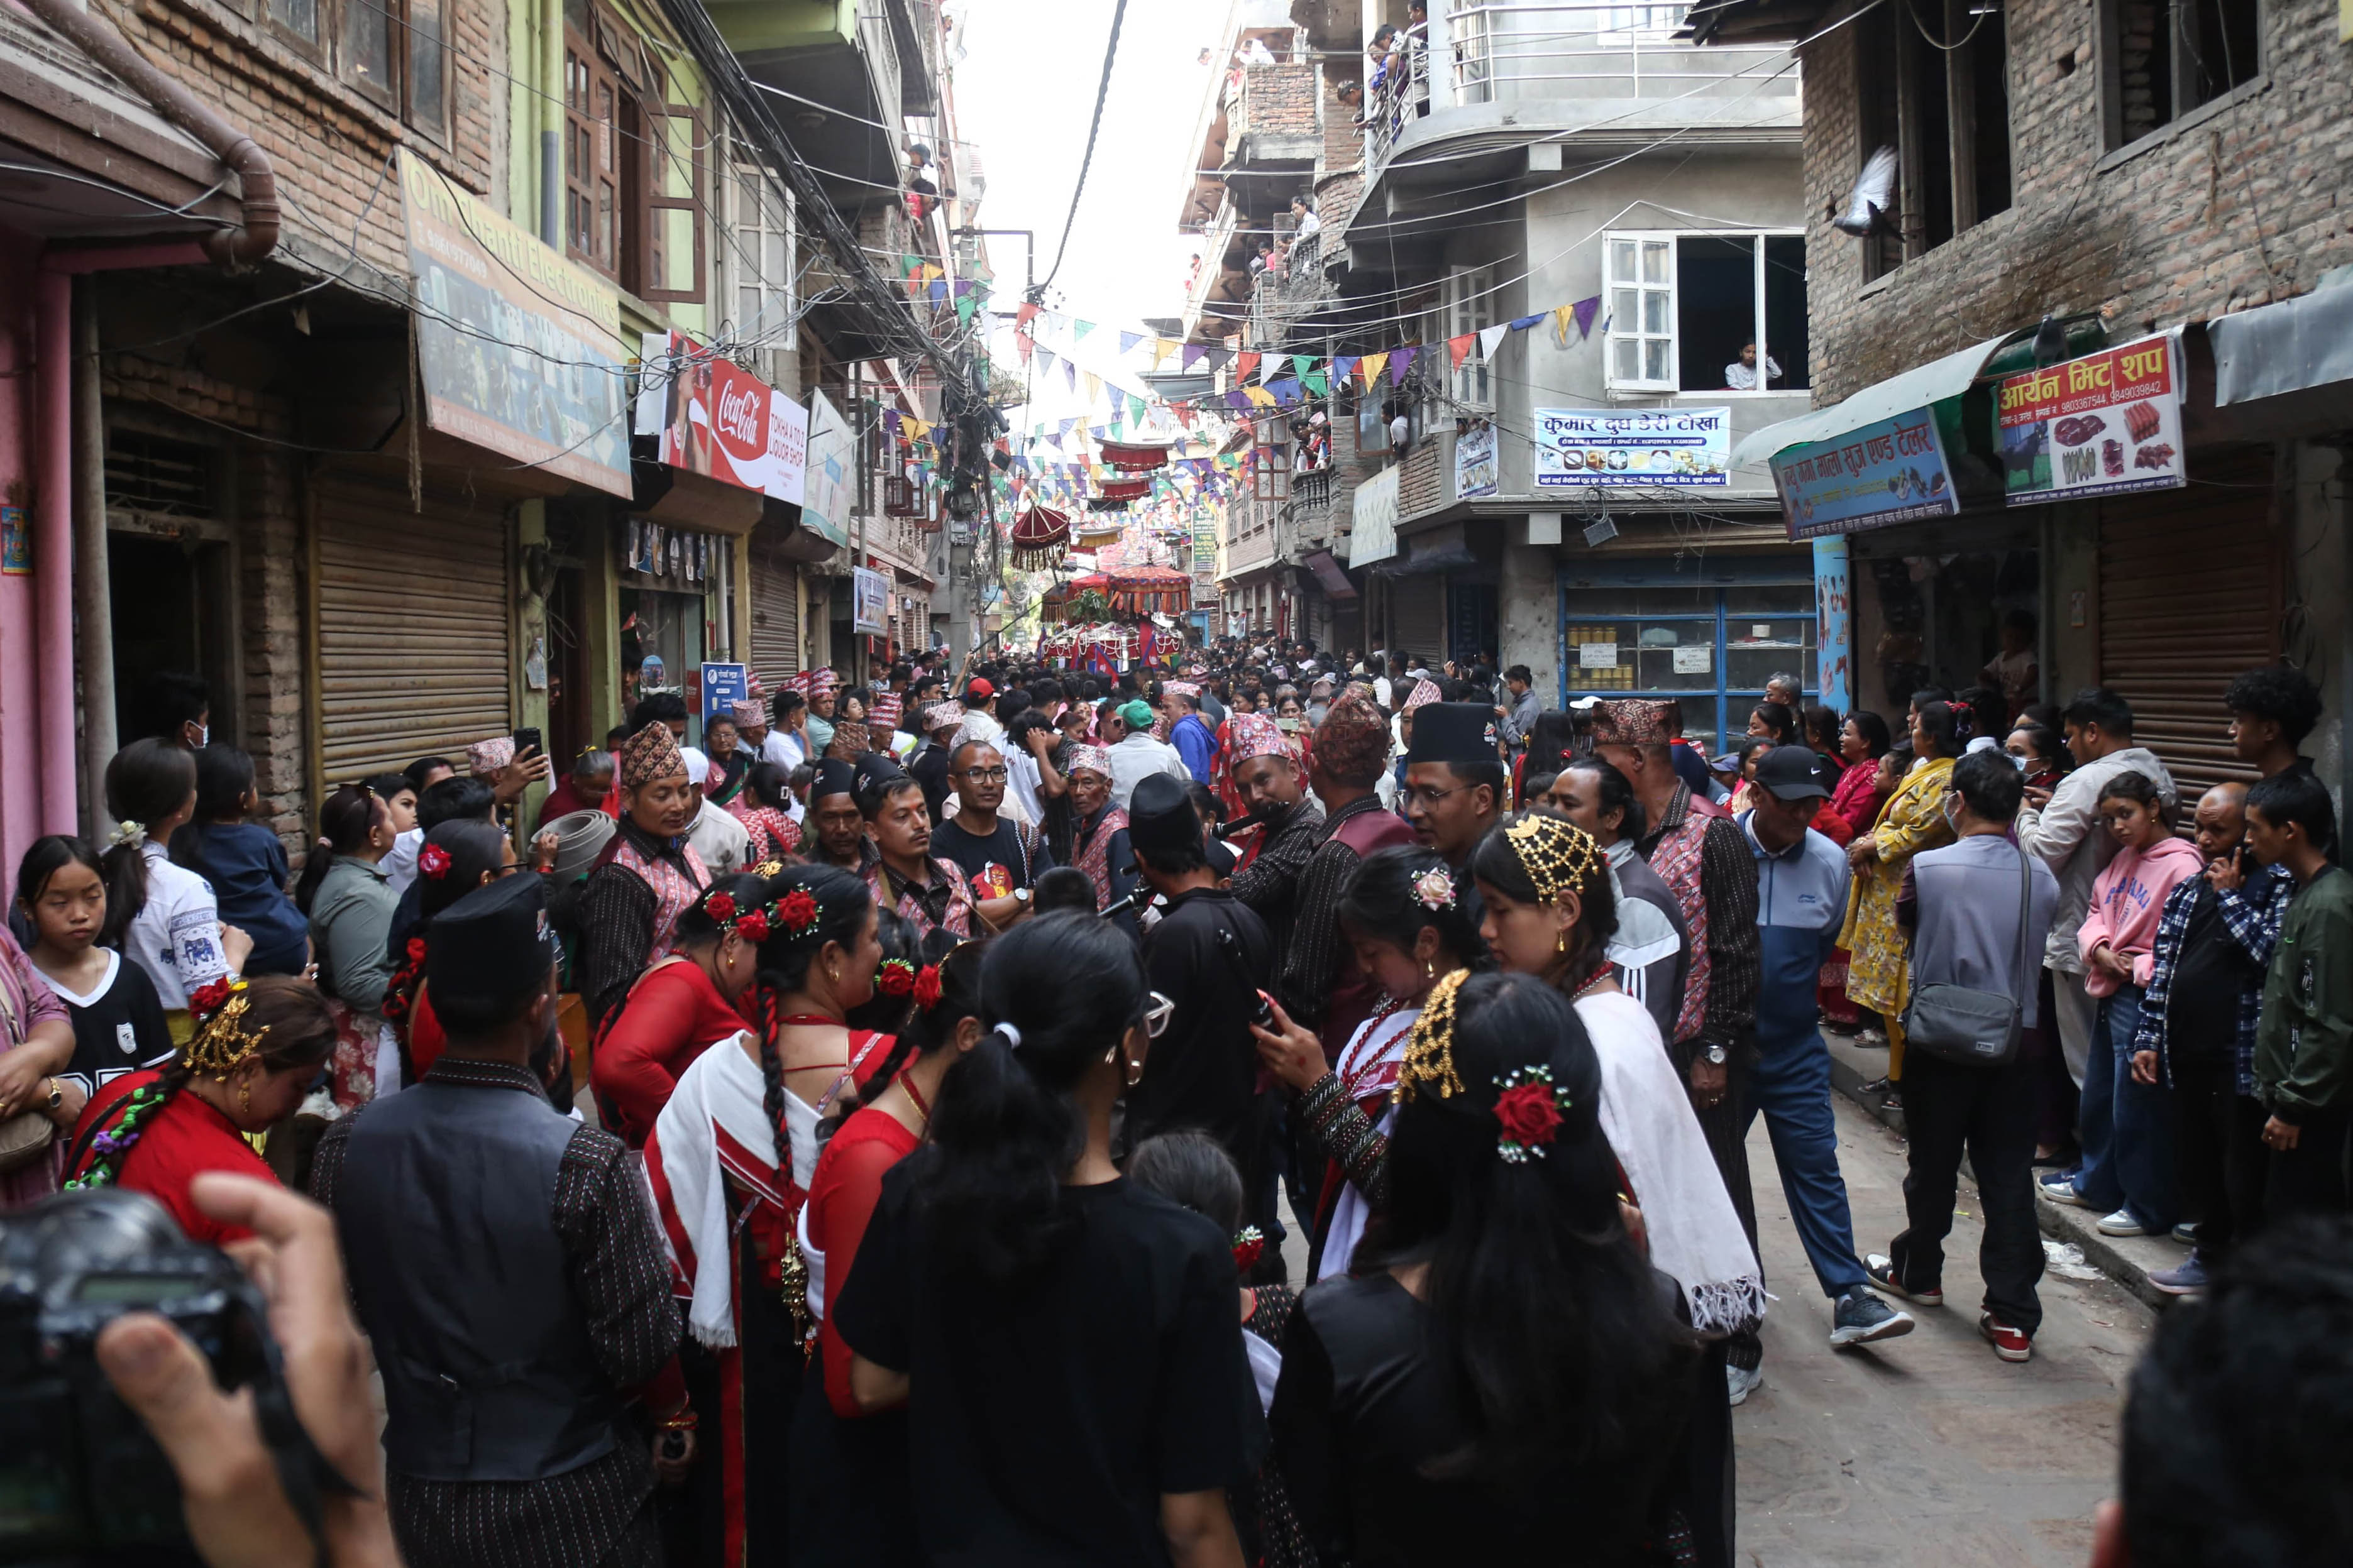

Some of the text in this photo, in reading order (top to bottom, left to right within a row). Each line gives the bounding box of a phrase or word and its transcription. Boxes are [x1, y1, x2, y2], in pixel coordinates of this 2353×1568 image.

[409, 162, 453, 228] Om
[527, 238, 617, 327] Electronics
[2000, 347, 2163, 410] आर्यन मिट शप
[2110, 381, 2162, 403] 9849039842
[770, 413, 788, 436] TOKHA
[1544, 417, 1598, 434] कुमार
[1893, 422, 1934, 458] टेलर
[769, 436, 803, 468] LIQUOR SHOP
